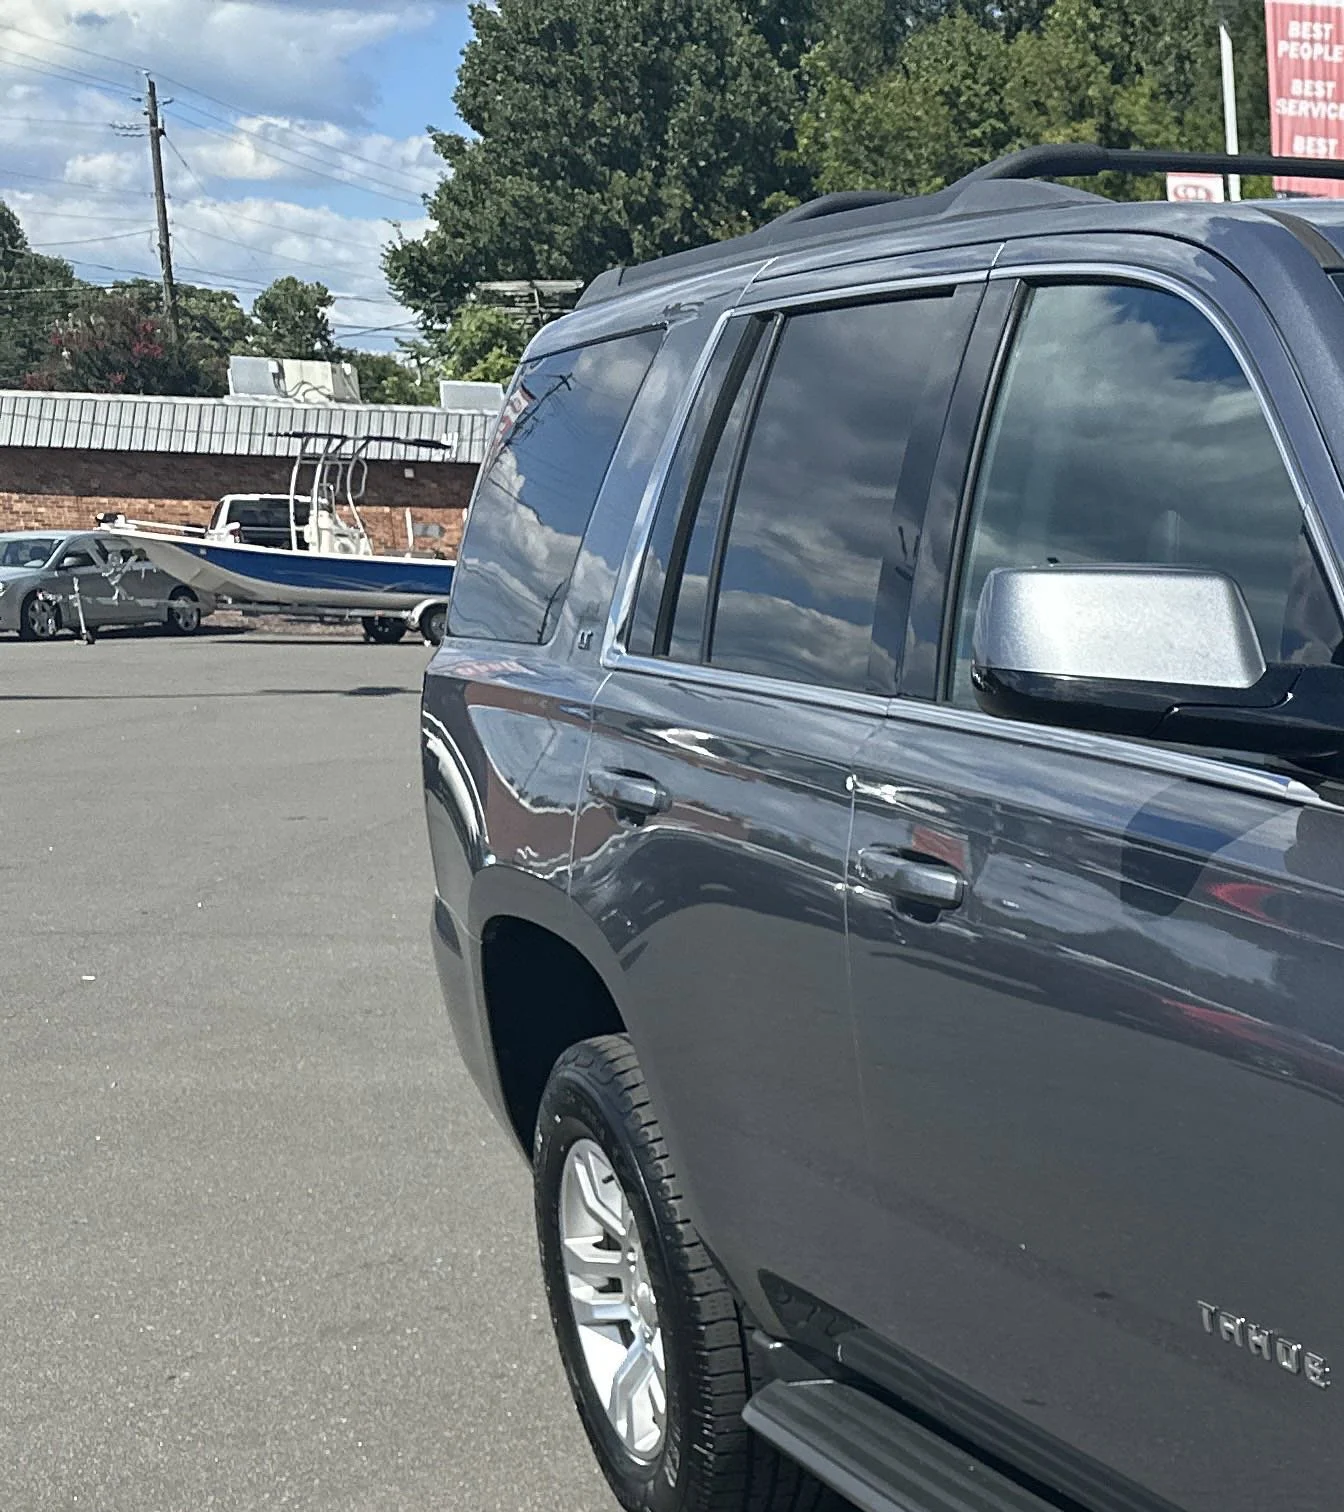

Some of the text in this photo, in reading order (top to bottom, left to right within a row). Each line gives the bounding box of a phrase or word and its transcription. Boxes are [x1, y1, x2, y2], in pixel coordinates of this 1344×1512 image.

[1288, 20, 1335, 40] BEST
[1277, 40, 1344, 63] PEOPLE
[1291, 78, 1336, 99] BEST
[1292, 135, 1338, 156] BEST
[1197, 1299, 1332, 1390] TAHOE
